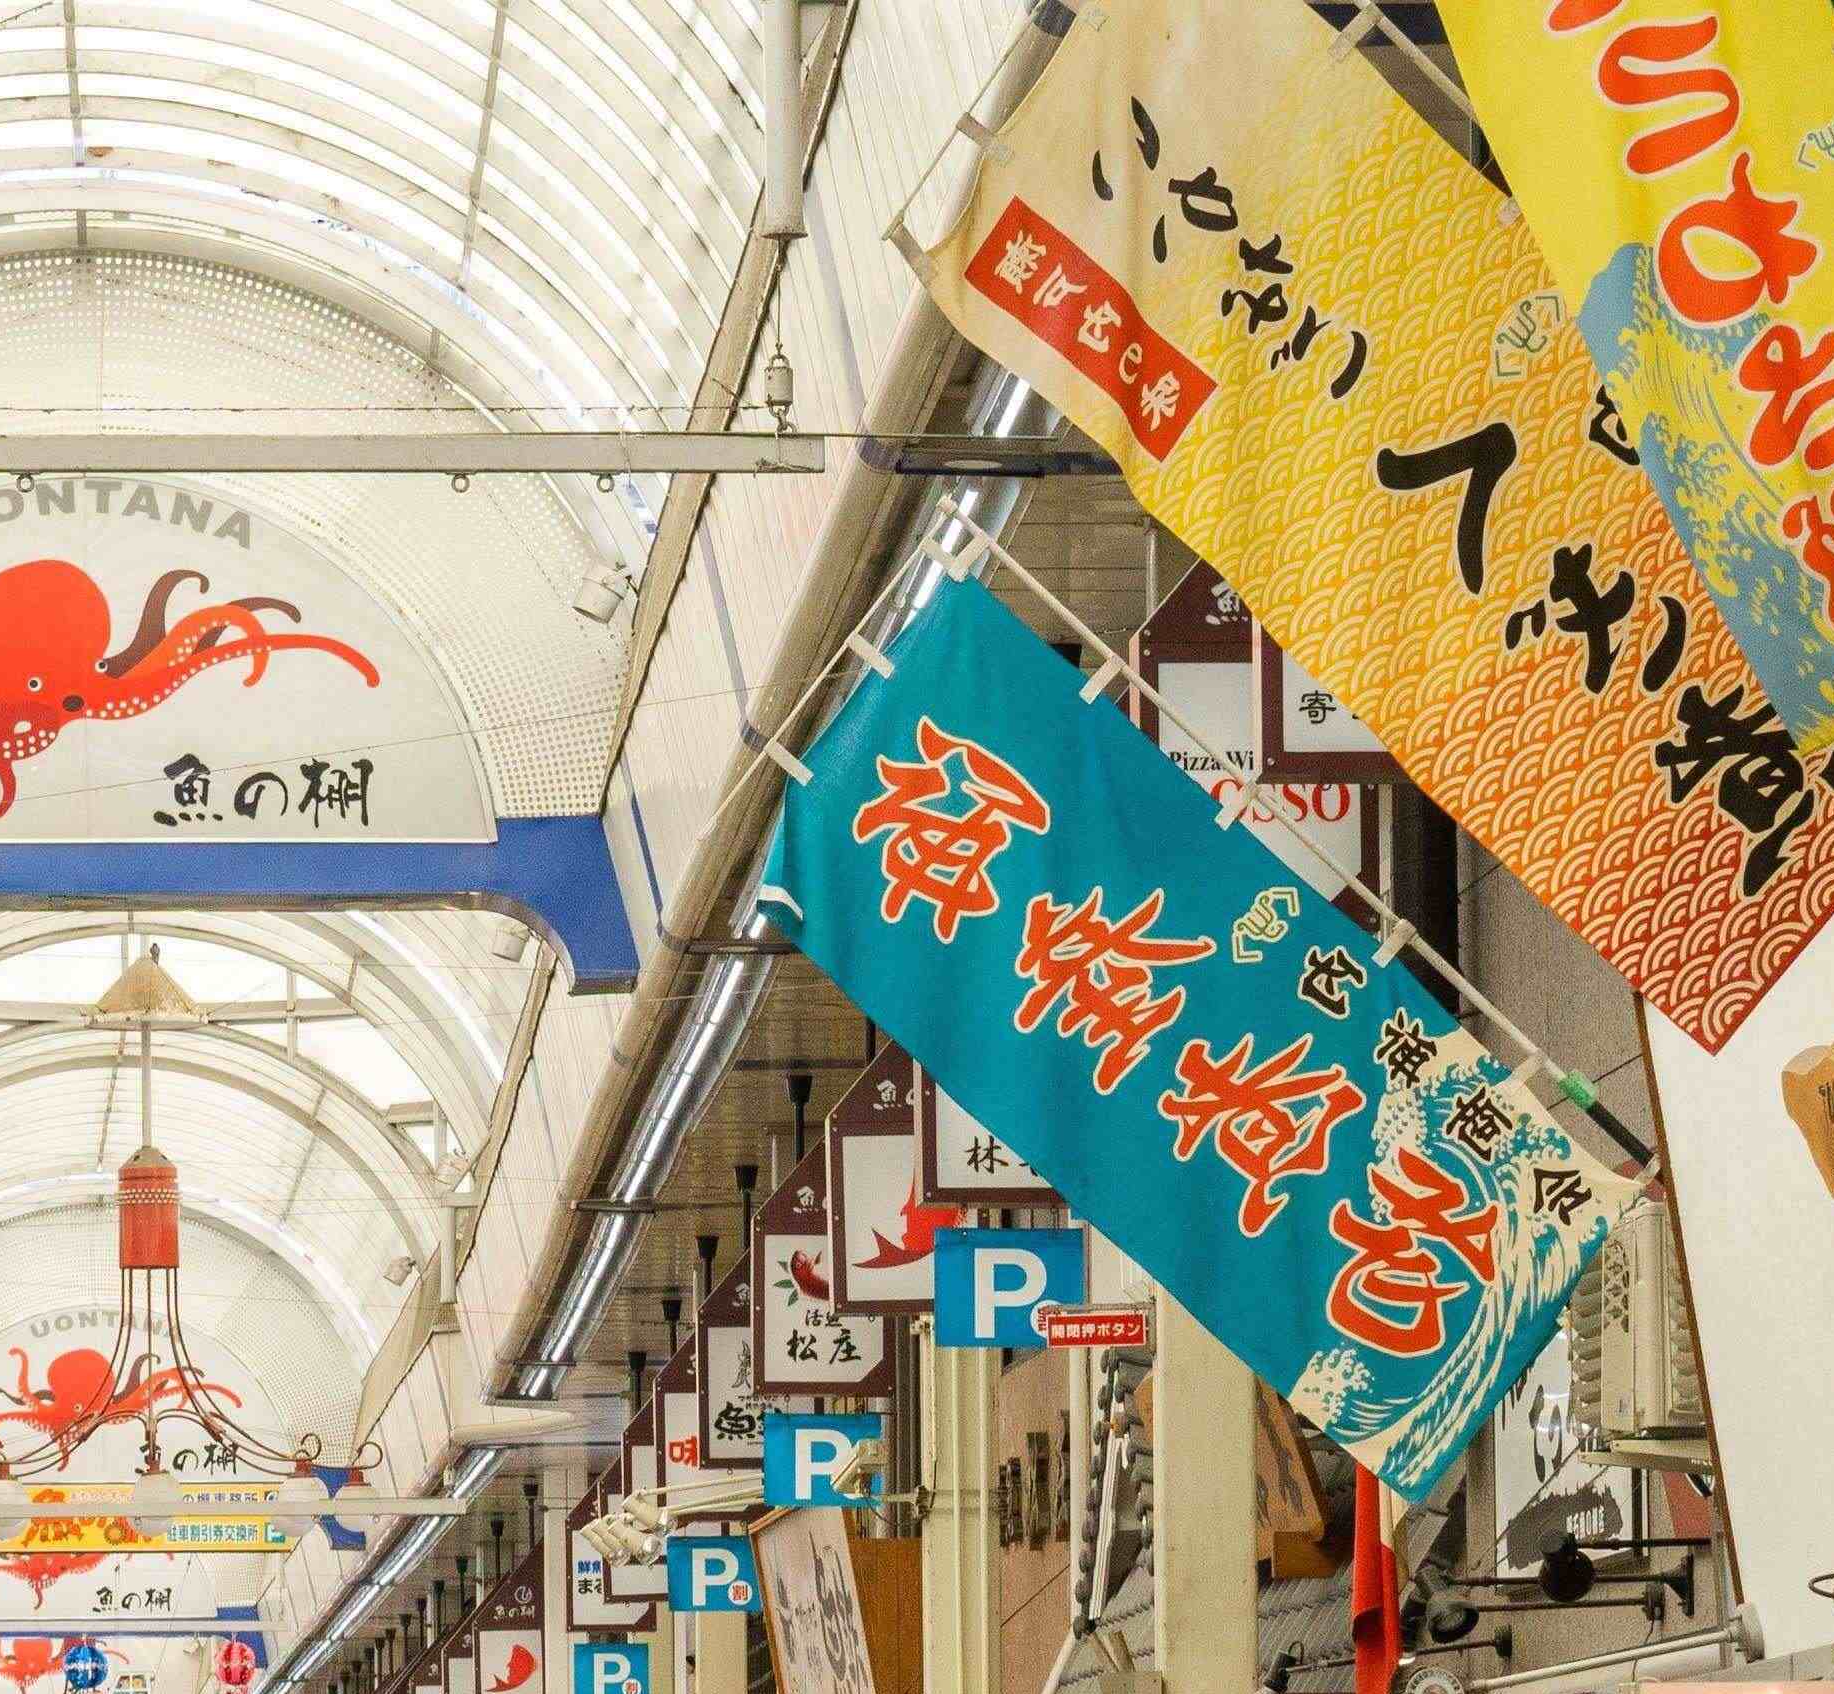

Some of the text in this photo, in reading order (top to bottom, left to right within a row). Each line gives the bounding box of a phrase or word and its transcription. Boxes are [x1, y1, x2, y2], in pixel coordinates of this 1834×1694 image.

[152, 753, 374, 827] 魚の棚
[974, 1247, 1047, 1338] P
[786, 1329, 862, 1364] 松庄
[1050, 1320, 1142, 1340] 開閉押ボタン
[795, 1429, 851, 1499] P
[691, 1547, 739, 1607] P
